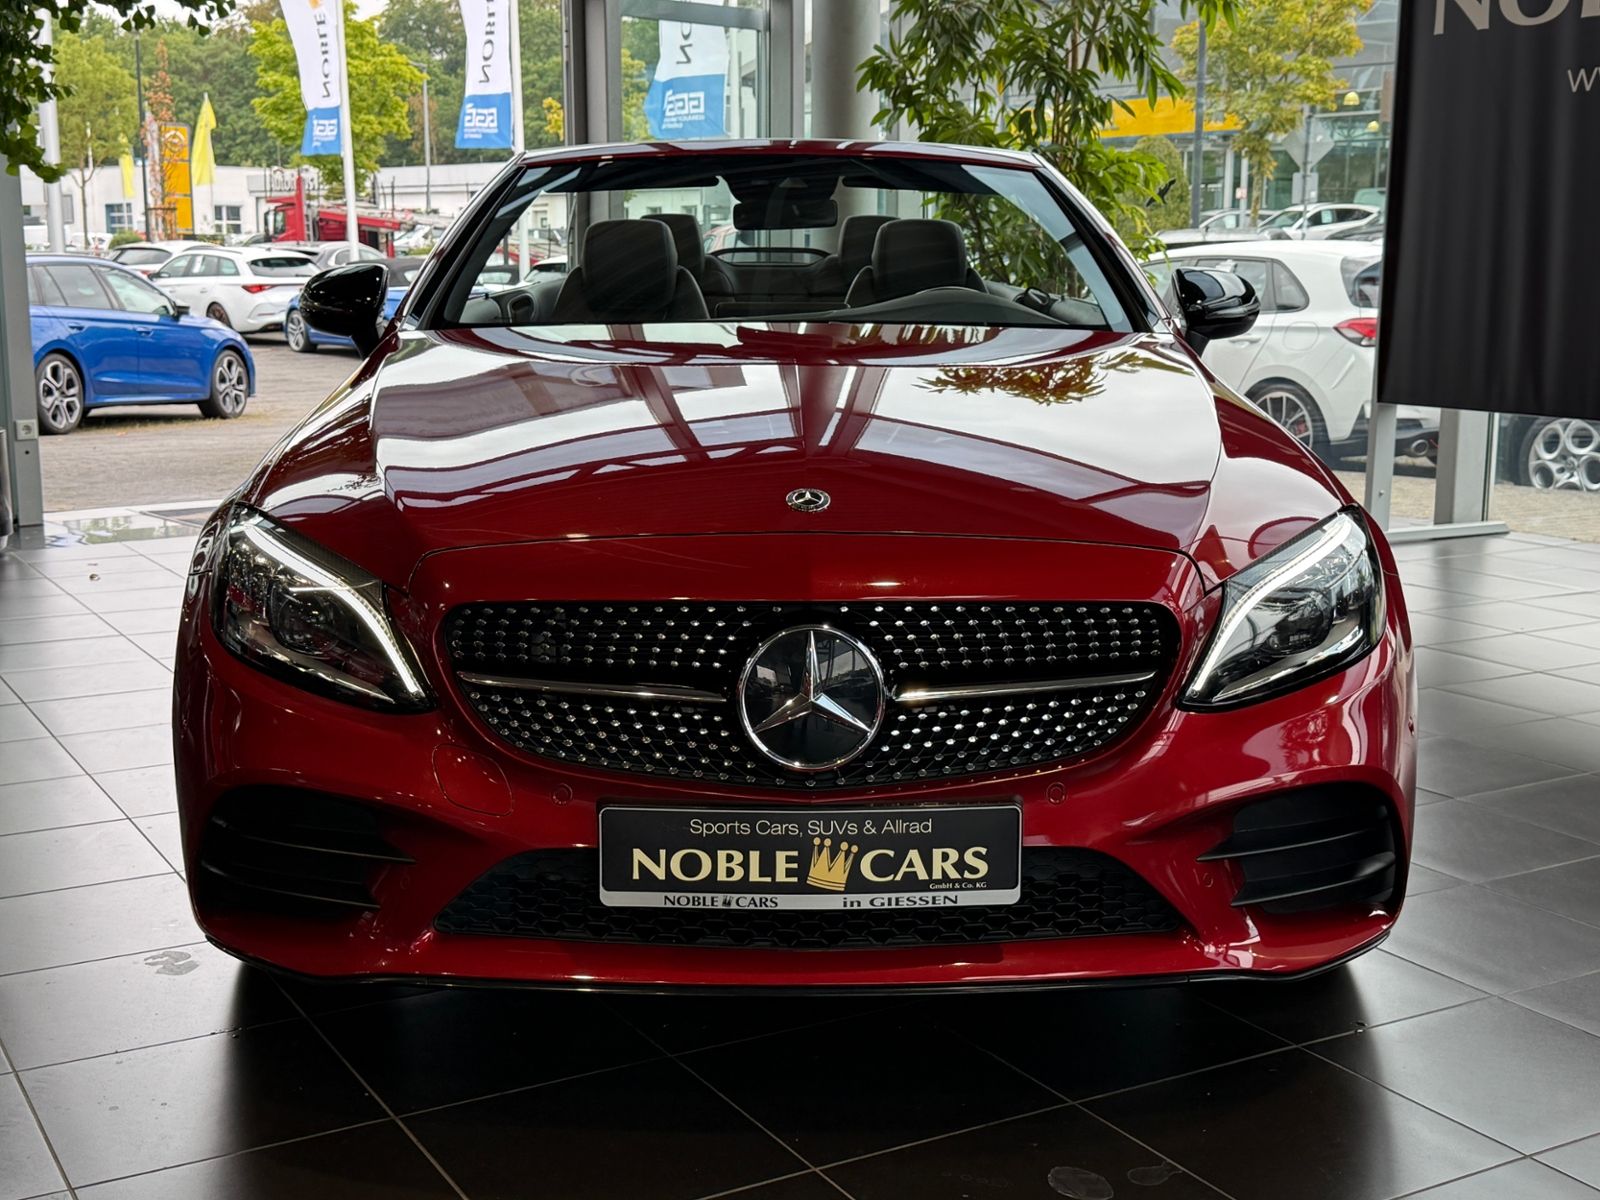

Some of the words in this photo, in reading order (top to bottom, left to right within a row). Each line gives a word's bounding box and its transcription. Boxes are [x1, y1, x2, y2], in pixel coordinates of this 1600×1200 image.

[1433, 0, 1600, 35] NO
[689, 818, 751, 837] Sports
[755, 819, 803, 838] Cars,
[807, 819, 858, 835] SUVs
[863, 819, 877, 834] &
[881, 818, 933, 834] Allrad
[632, 848, 799, 882] NOBLE
[860, 847, 989, 882] CARS
[929, 882, 953, 890] GmbH
[962, 881, 975, 889] Co.
[663, 895, 719, 907] NOBLE
[735, 896, 779, 908] CARS
[842, 897, 861, 908] in
[869, 895, 959, 907] GIESSEN
